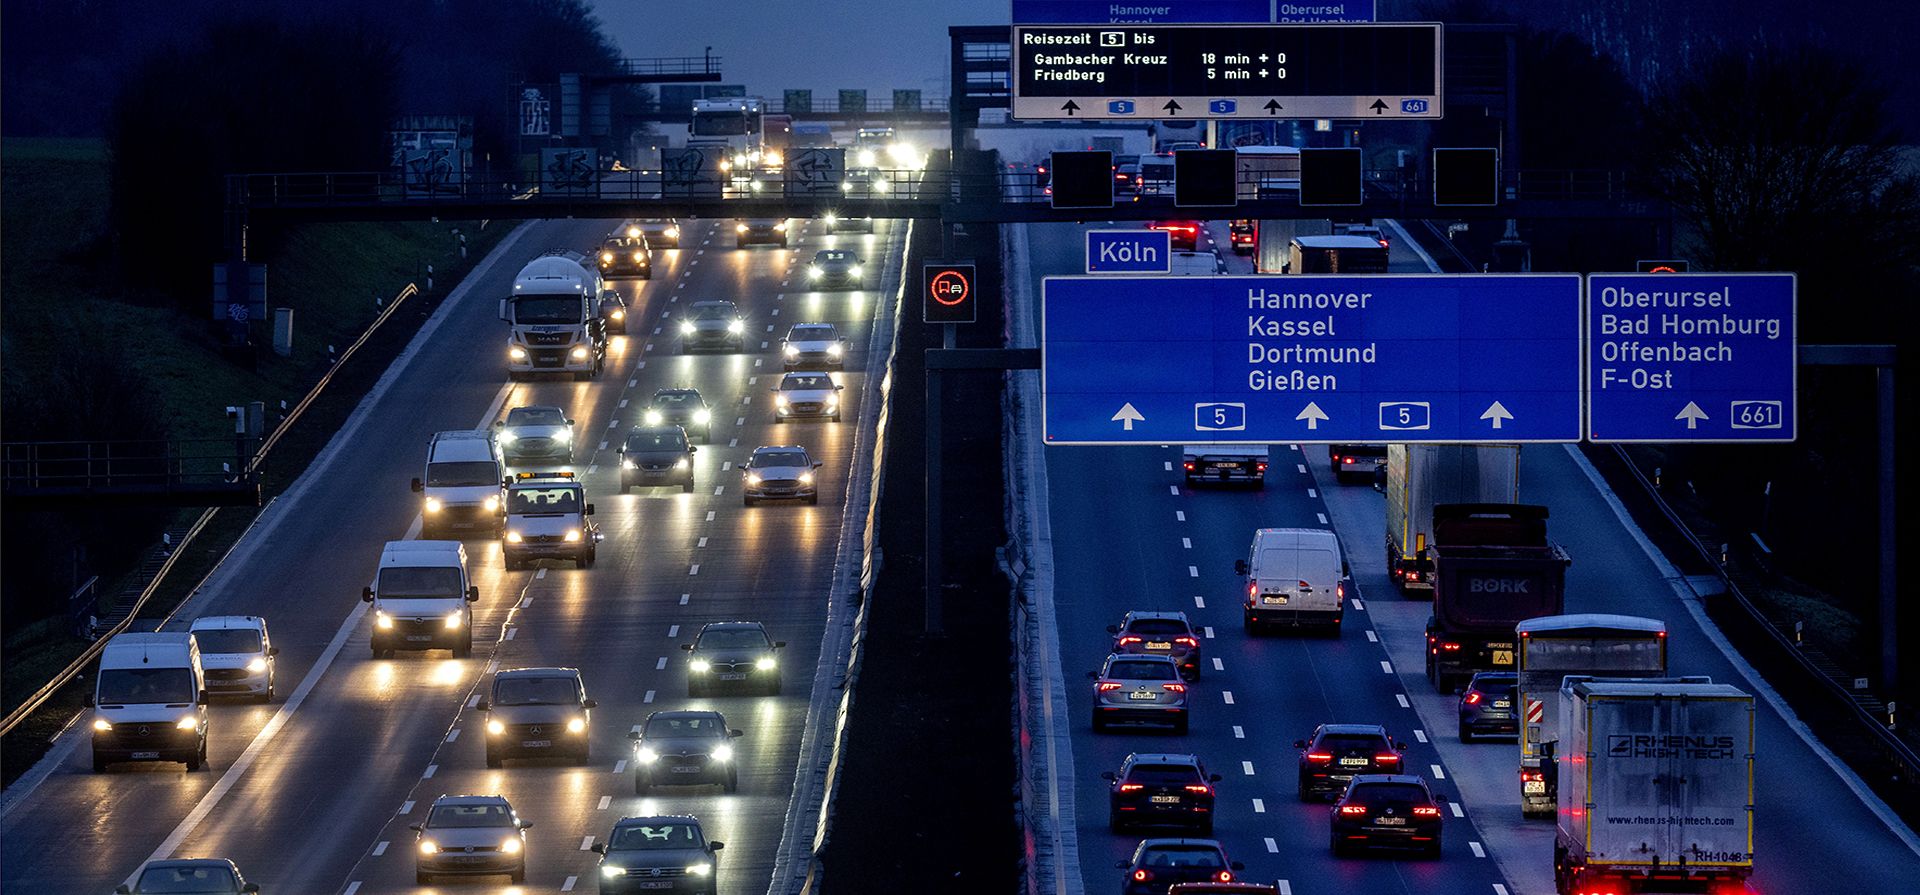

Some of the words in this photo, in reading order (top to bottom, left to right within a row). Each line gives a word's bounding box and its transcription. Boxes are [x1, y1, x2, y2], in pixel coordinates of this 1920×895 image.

[1110, 4, 1171, 15] Hannover
[1281, 4, 1344, 15] Oberursel
[1023, 33, 1091, 45] Reisezeit
[1108, 34, 1117, 44] 5
[1134, 33, 1156, 44] bis
[1034, 53, 1116, 65] Gambacher
[1123, 53, 1168, 65] Kreuz
[1201, 53, 1216, 64] 18
[1224, 53, 1250, 64] min
[1258, 53, 1269, 63] +
[1277, 53, 1286, 64] 0
[1034, 69, 1105, 83] Friedberg
[1207, 68, 1216, 79] 5
[1224, 68, 1250, 79] min
[1258, 68, 1269, 78] +
[1277, 68, 1286, 79] 0
[1118, 102, 1125, 112] 5
[1219, 102, 1226, 112] 5
[1406, 101, 1424, 112] 661
[1100, 241, 1157, 262] Köln
[1248, 288, 1373, 309] Hannover
[1601, 287, 1731, 307] Oberursel
[1248, 315, 1336, 336] Kassel
[1601, 314, 1649, 335] Bad
[1661, 314, 1781, 340] Homburg
[1248, 343, 1376, 363] Dortmund
[1601, 341, 1733, 362] Offenbach
[1248, 369, 1337, 390] Gießen
[1601, 368, 1673, 389] F-Ost
[1214, 409, 1226, 425] 5
[1398, 408, 1411, 425] 5
[1741, 406, 1773, 423] 661
[1470, 578, 1530, 594] BORK
[1497, 652, 1508, 662] A
[1635, 735, 1734, 748] RHENUS
[1686, 749, 1734, 759] TECH
